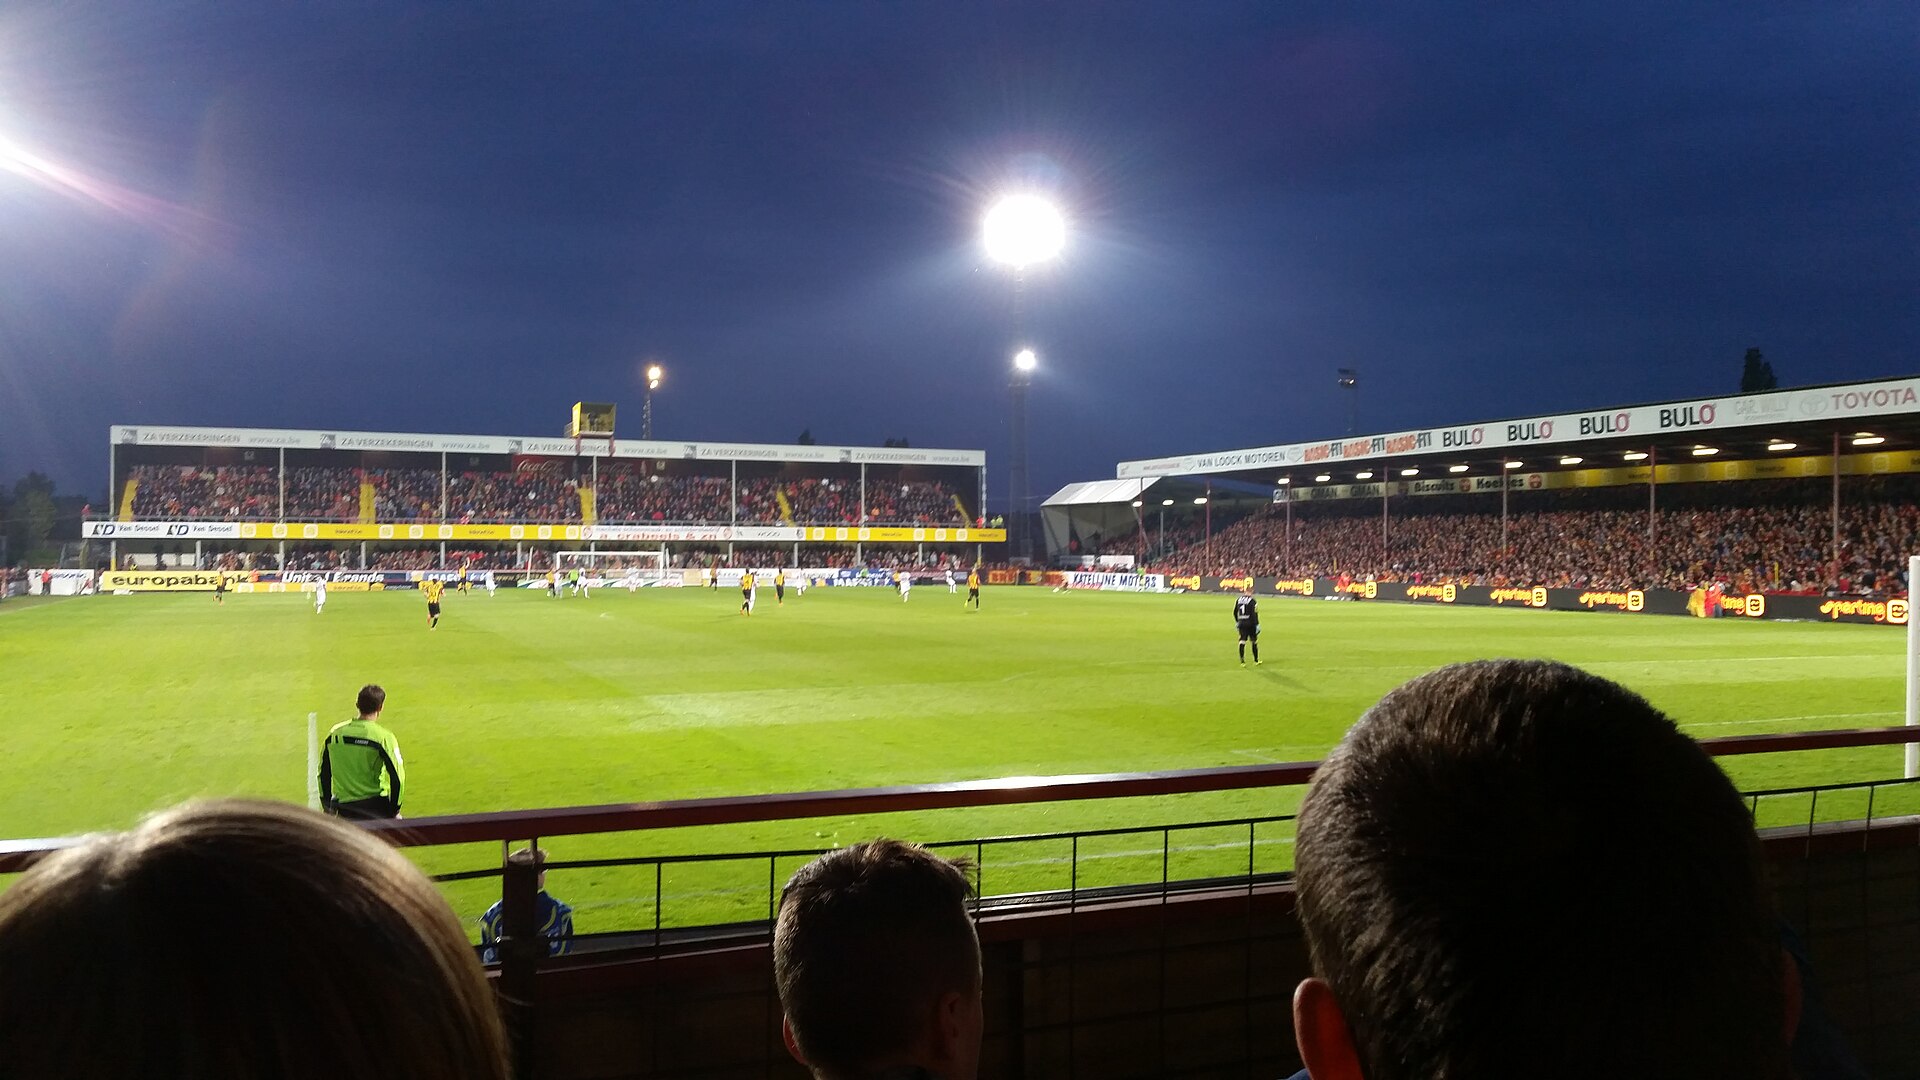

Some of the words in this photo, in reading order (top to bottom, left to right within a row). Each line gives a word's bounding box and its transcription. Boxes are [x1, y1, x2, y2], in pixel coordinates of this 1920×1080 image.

[1832, 387, 1917, 410] TOYOTA
[358, 438, 434, 449] VERZEKERINGEN
[540, 443, 613, 454] VERZEKRINGE
[714, 449, 778, 458] VERZEKERINGEN
[867, 453, 927, 462] VERZEKERINGEN
[1197, 458, 1213, 468] VAN
[1215, 455, 1242, 467] LOOCK
[1245, 451, 1286, 464] MOTOREN
[1414, 479, 1454, 492] Biscuits
[111, 573, 249, 588] europabank
[1579, 589, 1629, 609] sporting
[1240, 604, 1246, 615] 1
[1820, 599, 1886, 622] sporting
